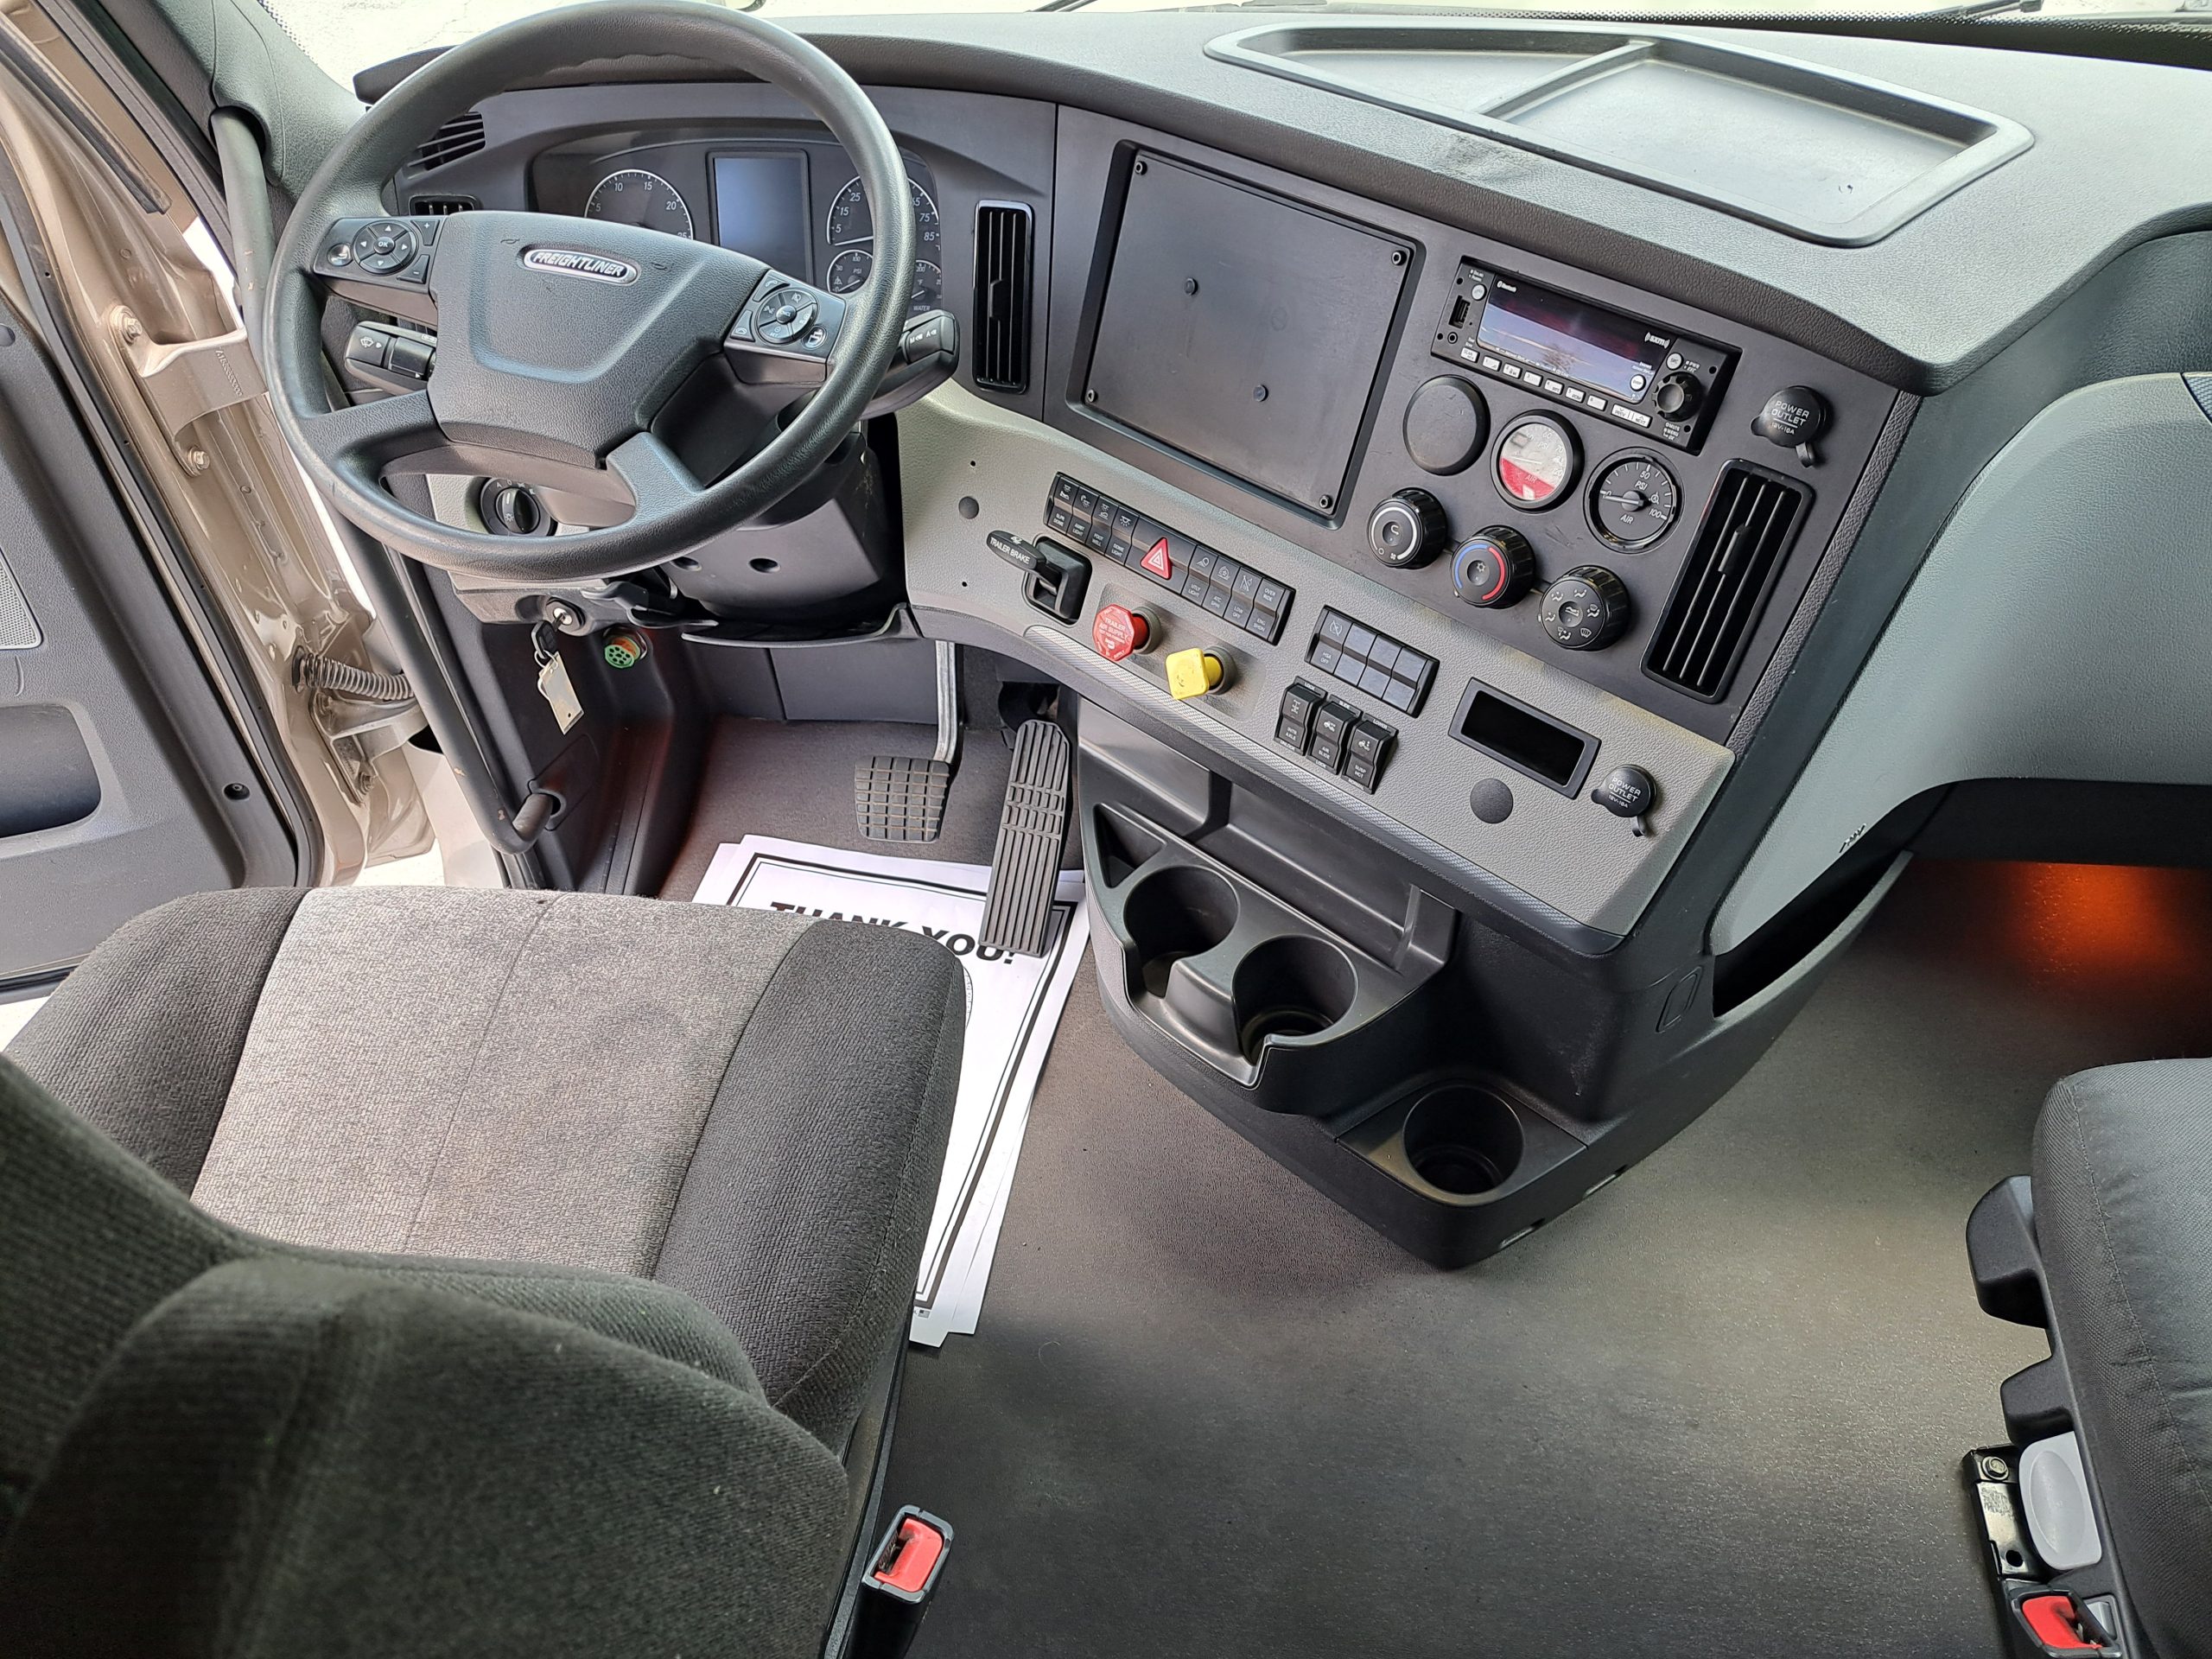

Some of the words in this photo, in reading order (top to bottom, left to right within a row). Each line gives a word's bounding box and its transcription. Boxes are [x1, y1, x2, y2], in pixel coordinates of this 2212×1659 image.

[614, 182, 623, 192] 10
[644, 181, 652, 191] 15
[849, 192, 861, 202] 25
[595, 203, 601, 212] 5
[666, 200, 677, 210] 20
[840, 207, 849, 216] 15
[918, 213, 931, 222] 75
[835, 224, 842, 233] 5
[924, 232, 935, 241] 85
[532, 251, 625, 276] FREIGHTLINER
[1775, 400, 1810, 419] POWER
[1771, 408, 1807, 426] OUTLET
[1524, 474, 1538, 483] AIR
[1639, 470, 1650, 480] 50
[1634, 480, 1649, 491] PSI
[1649, 508, 1662, 518] 100
[1620, 514, 1634, 524] AIR
[1072, 528, 1084, 537] LIGHT
[1093, 532, 1104, 541] FOOT
[1091, 538, 1102, 547] WELL
[1113, 543, 1125, 552] DOME
[989, 537, 1011, 554] TRAILER
[1009, 549, 1030, 564] BRAKE
[1188, 588, 1200, 597] LIGHT
[1264, 588, 1276, 597] OVER
[1262, 594, 1273, 602] RIDE
[1105, 617, 1126, 631] TRAILER
[1108, 626, 1129, 640] SUPPLY
[1323, 652, 1332, 660] HSA
[1304, 682, 1315, 691] LOCK
[1372, 718, 1388, 730] LOWER
[1285, 732, 1296, 741] AXLE
[1280, 740, 1296, 751] UNLOCK
[1315, 760, 1326, 769] LOCK
[1611, 777, 1642, 796] POWER
[1608, 783, 1638, 803] OUTLET
